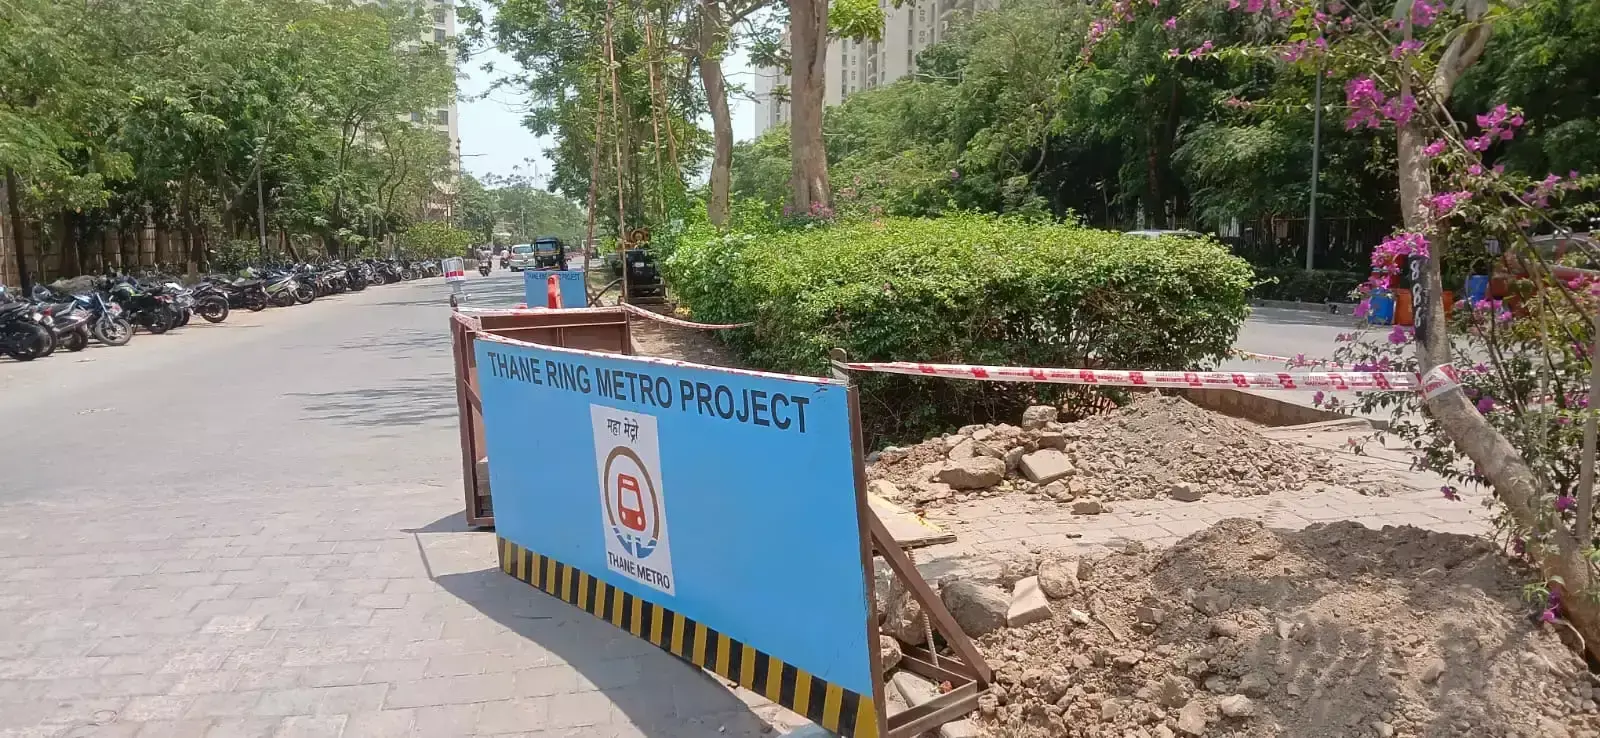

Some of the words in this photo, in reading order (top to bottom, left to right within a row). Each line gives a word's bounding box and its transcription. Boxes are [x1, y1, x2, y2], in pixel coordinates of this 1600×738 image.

[487, 351, 543, 386] THANE
[546, 360, 591, 394] RING
[594, 367, 673, 409] METRO
[679, 379, 810, 434] PROJECT
[607, 418, 621, 437] महा
[608, 551, 636, 576] THANE
[636, 566, 671, 590] METRO
